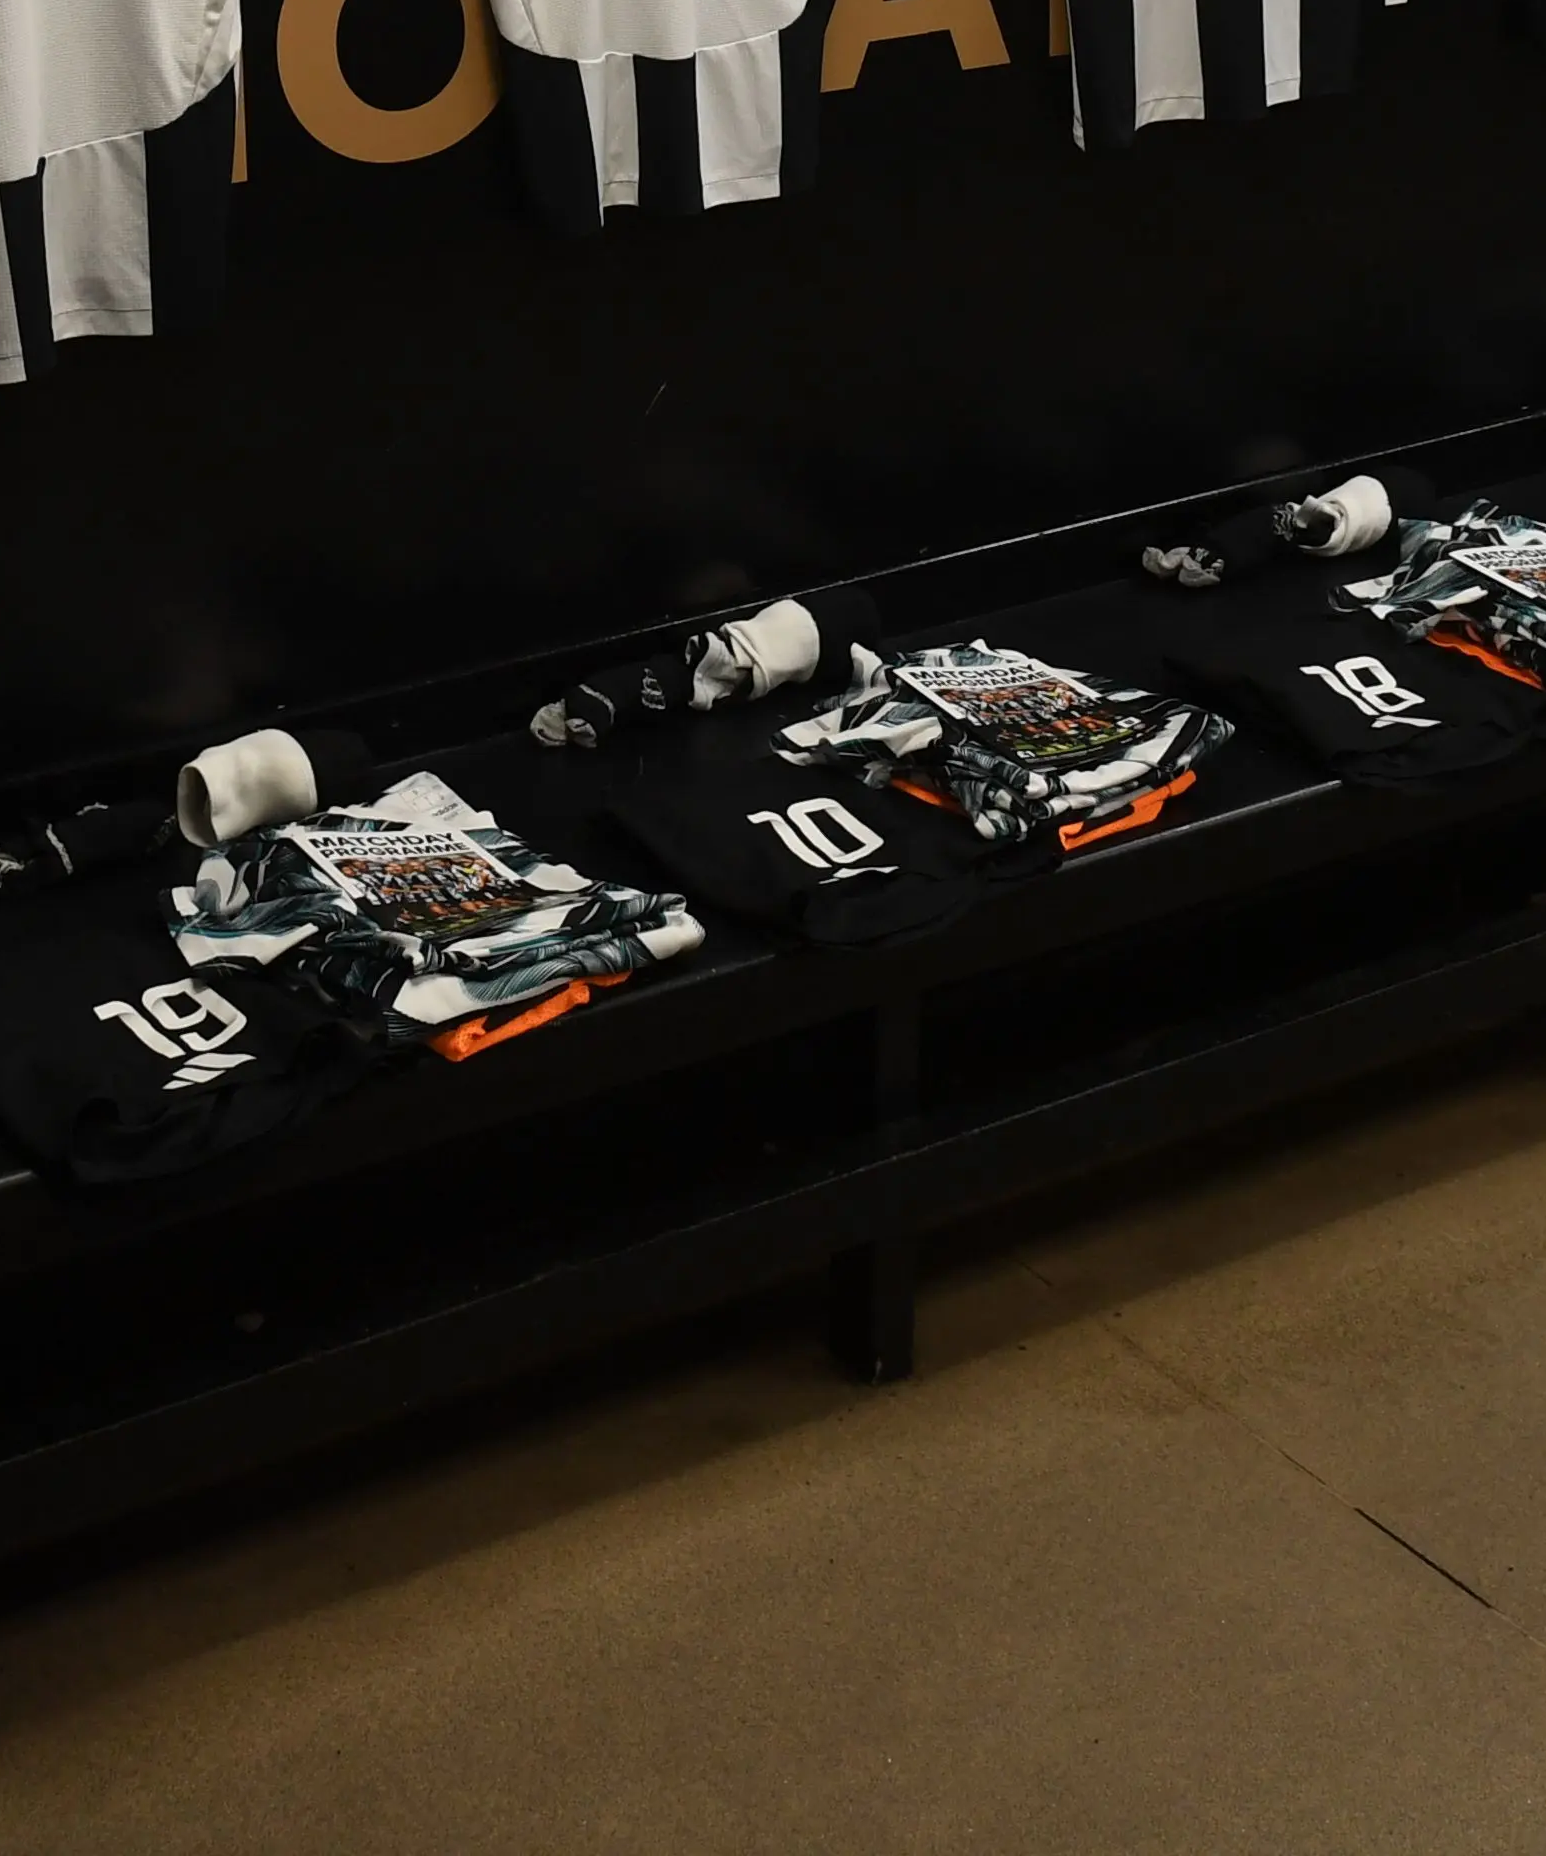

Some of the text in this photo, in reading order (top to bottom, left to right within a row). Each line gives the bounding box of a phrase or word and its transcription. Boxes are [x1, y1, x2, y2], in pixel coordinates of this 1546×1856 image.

[908, 664, 1036, 680] MATCHDAY
[920, 670, 1051, 688] PROGRAMME
[1300, 655, 1425, 715] 18
[310, 832, 455, 849] MATCHDAY
[746, 797, 884, 868] 10
[318, 841, 471, 858] PROGRAMME
[93, 977, 248, 1059] 19
